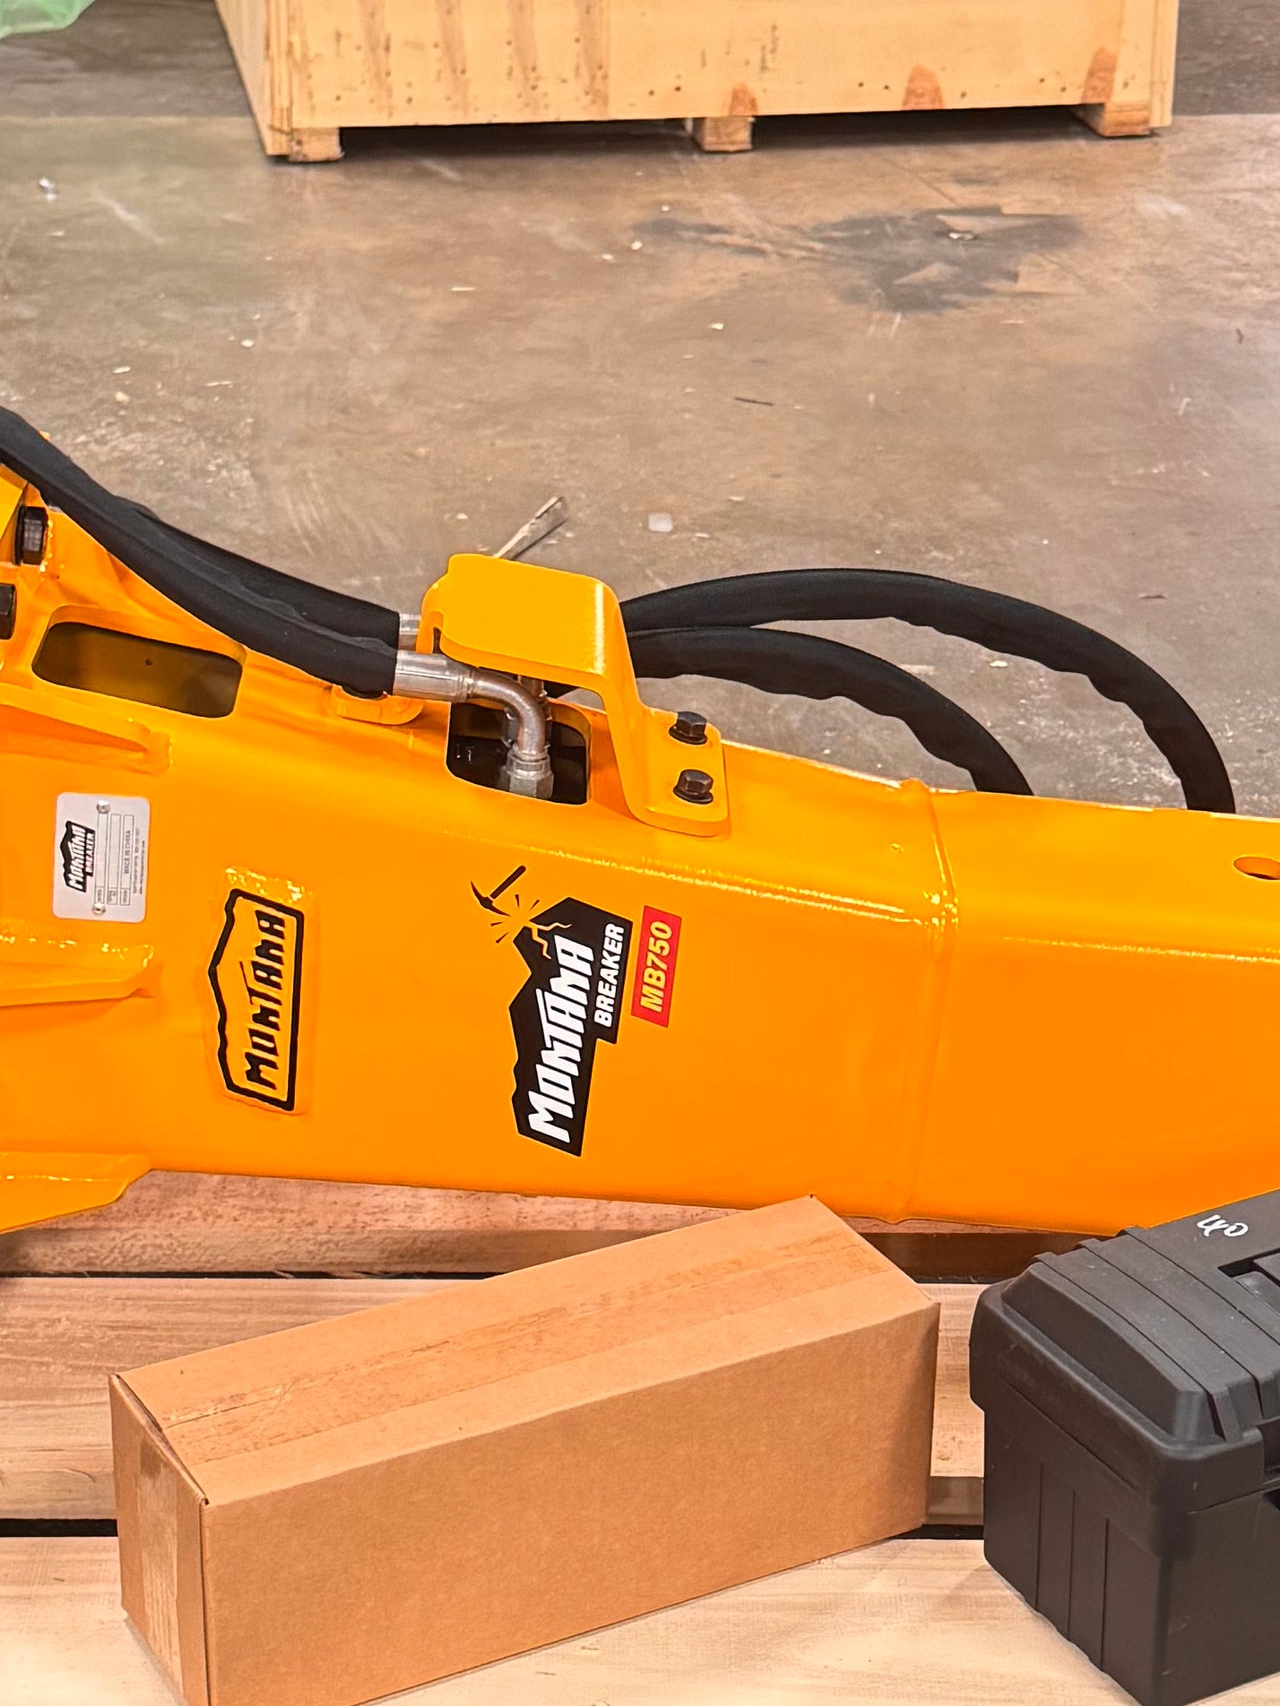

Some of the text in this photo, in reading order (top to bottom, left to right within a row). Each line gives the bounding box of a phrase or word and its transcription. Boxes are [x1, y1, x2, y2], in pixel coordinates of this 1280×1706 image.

[67, 824, 86, 890] MONTANA
[85, 832, 95, 874] BREAKER
[239, 909, 286, 1091] MONTANA
[593, 922, 625, 1029] BREAKER
[639, 920, 673, 1013] MB750
[527, 934, 595, 1144] MONTANA
